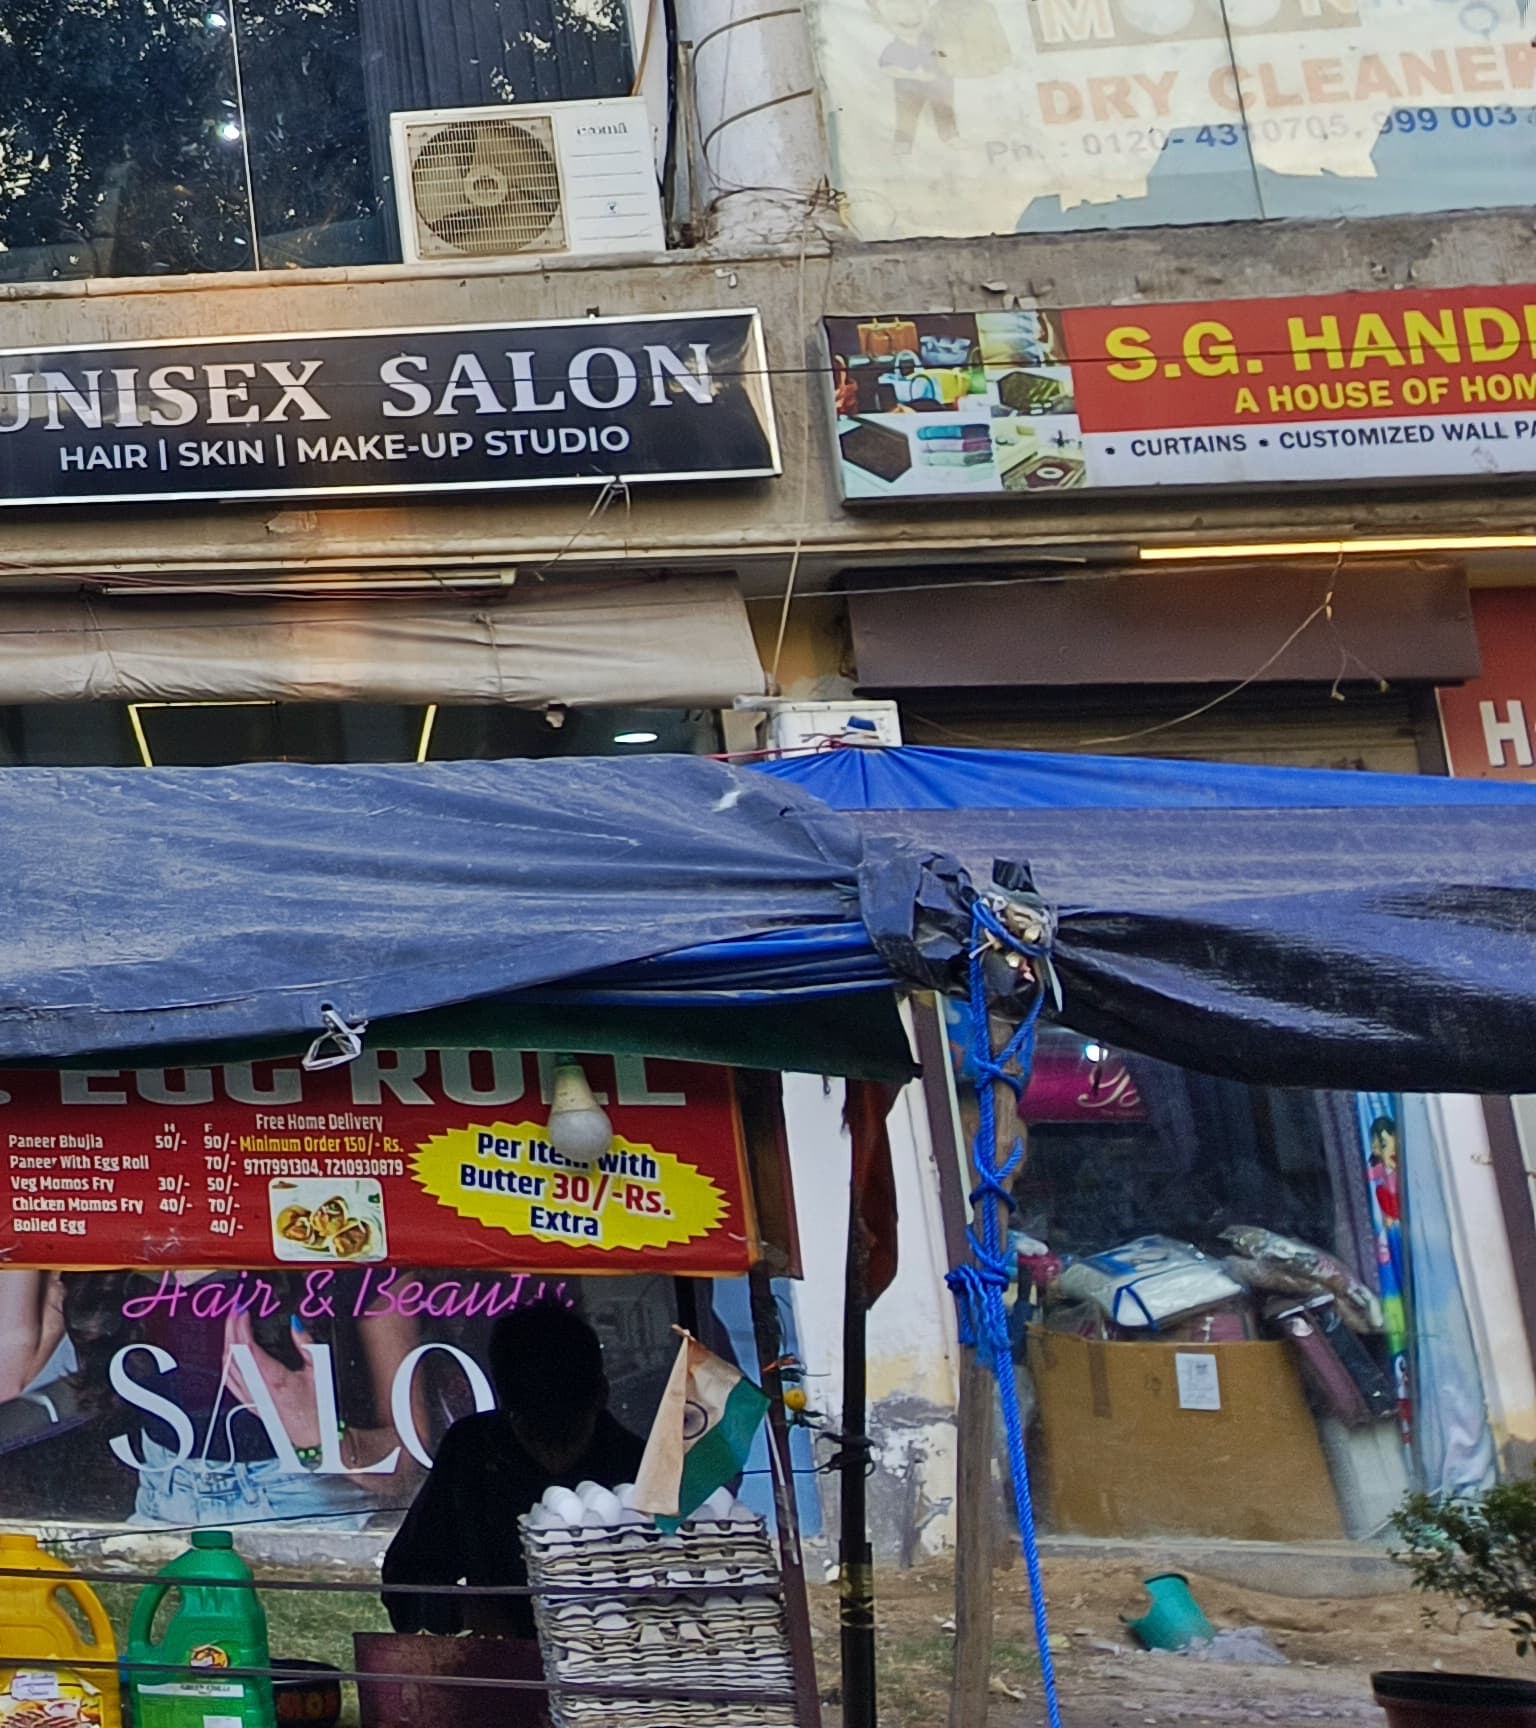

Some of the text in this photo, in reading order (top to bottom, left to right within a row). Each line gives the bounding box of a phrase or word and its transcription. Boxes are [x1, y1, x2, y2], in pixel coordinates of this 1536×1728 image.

[1037, 70, 1180, 126] DRY
[1105, 319, 1265, 382] S.G.
[379, 343, 714, 419] SALON
[1269, 377, 1449, 413] HOUSE OF
[60, 425, 631, 472] HAIR SKIN MAKE-UP STUDIO
[1130, 420, 1510, 458] CURTAINS CUSTOMIZED WALL
[255, 1113, 383, 1133] Free Home Delivery
[240, 1136, 301, 1153] Minimum
[477, 1132, 657, 1179] Per with
[460, 1164, 545, 1197] Butter
[530, 1205, 600, 1237] Extra
[122, 1269, 284, 1320] Hair
